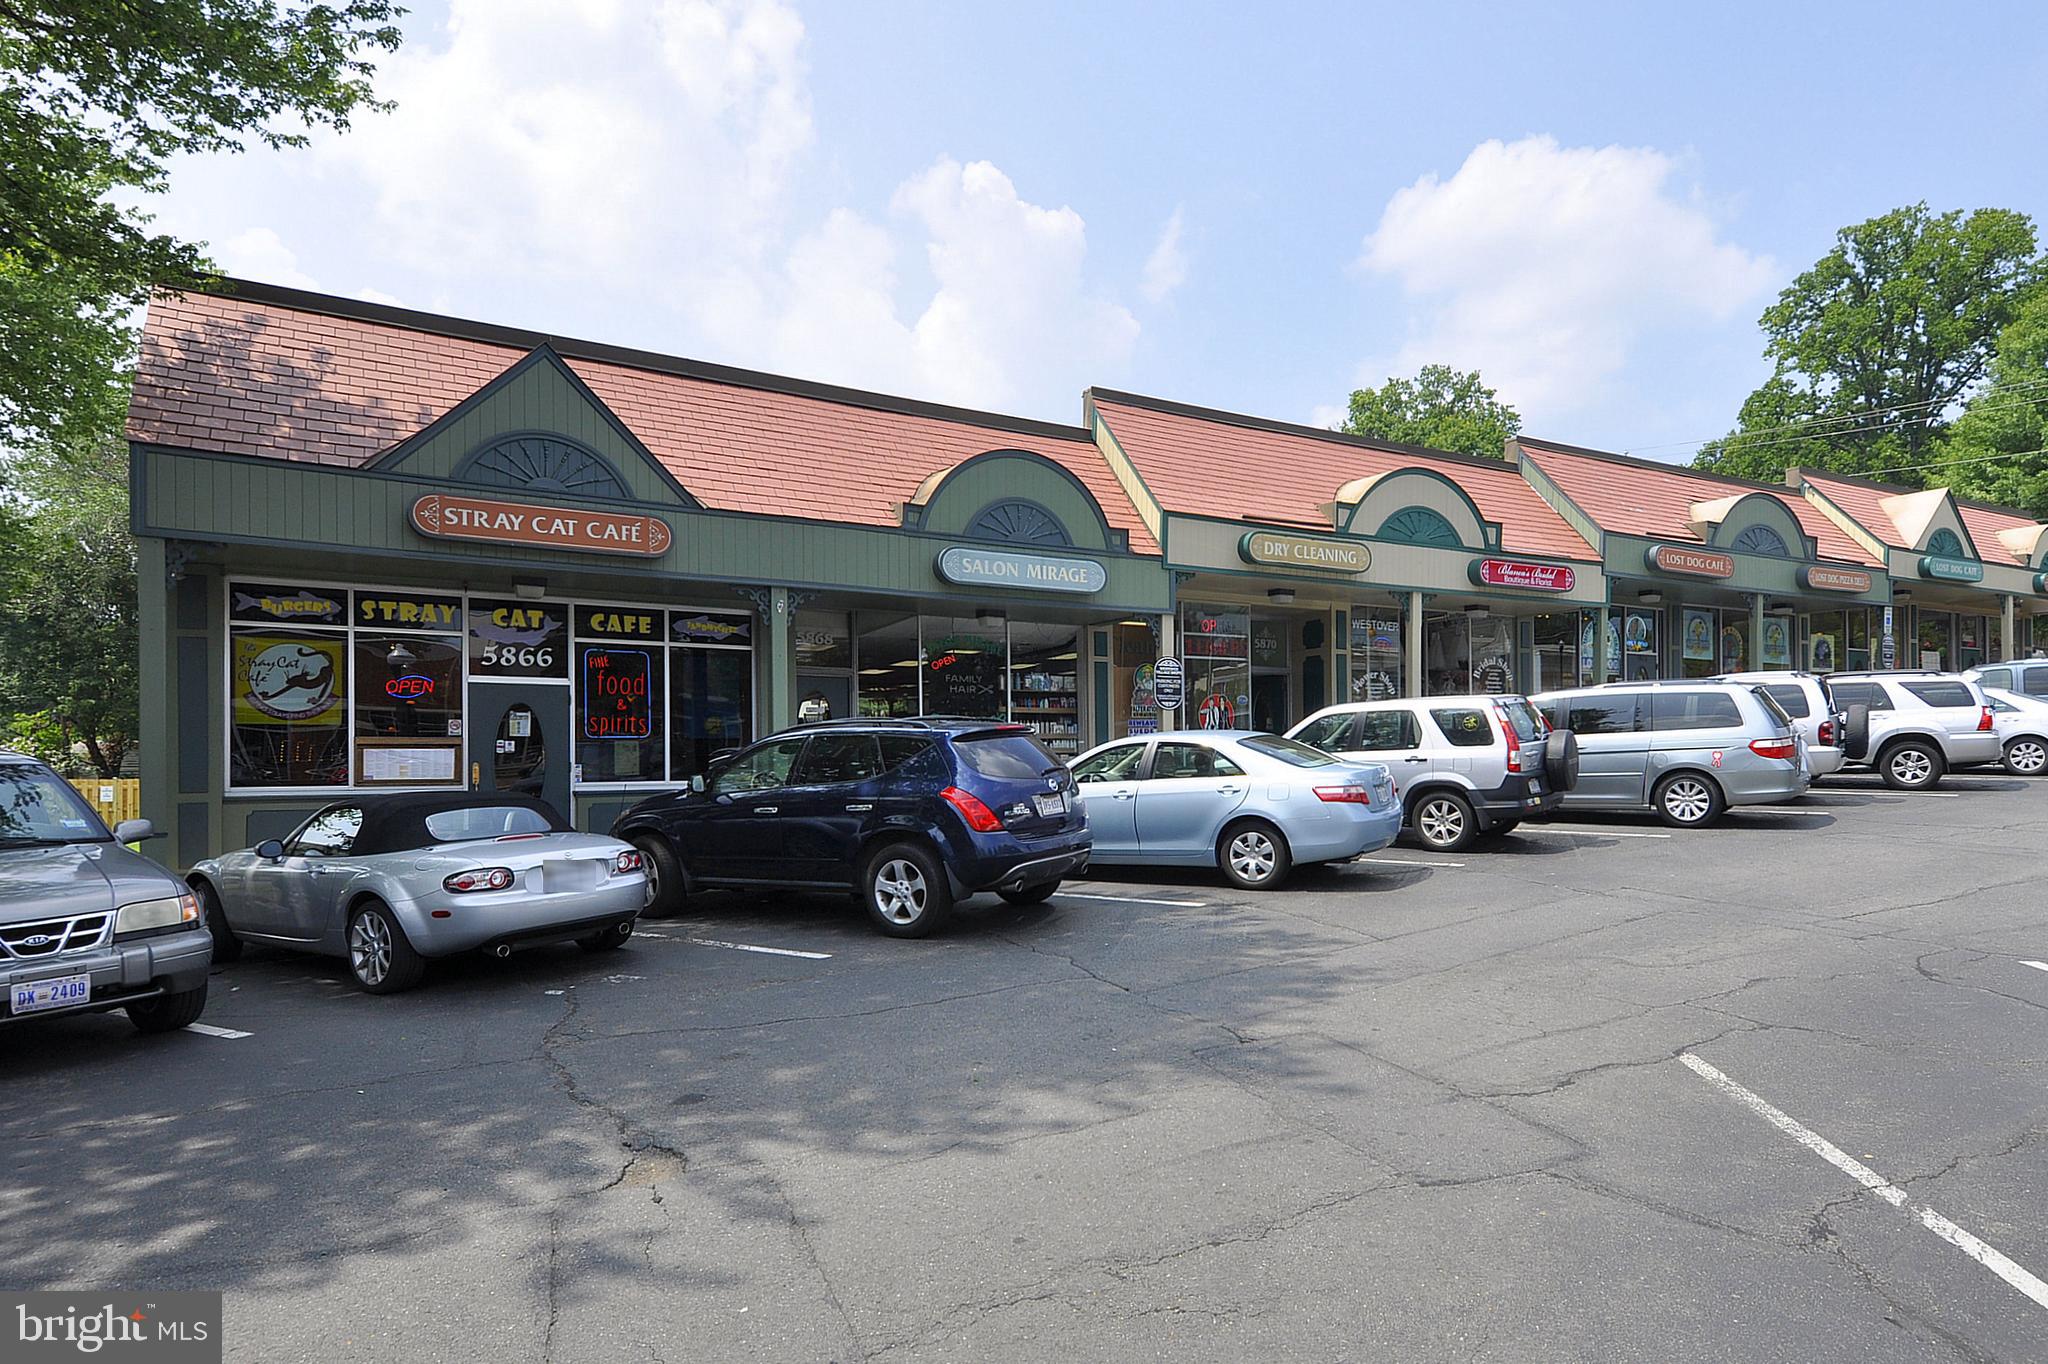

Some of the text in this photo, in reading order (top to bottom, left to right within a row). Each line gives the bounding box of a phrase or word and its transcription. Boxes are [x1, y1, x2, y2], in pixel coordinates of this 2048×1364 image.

[444, 506, 643, 543] STRAY CAT CAFÉ
[1264, 541, 1357, 564] DRY CLEANING
[1666, 554, 1685, 565] LOST
[1687, 556, 1705, 568] DOG
[1935, 562, 1950, 572] LOST
[1951, 565, 1963, 574] DOG
[962, 556, 1089, 584] SALON MIRAGE
[1531, 567, 1558, 580] Bridal
[1503, 575, 1530, 585] Boutique
[1530, 577, 1536, 585] &
[1828, 574, 1839, 583] DOG
[260, 598, 332, 615] BURGERS
[360, 600, 652, 634] STRAY CAT CAFE
[1352, 618, 1400, 632] WESTOVER
[795, 631, 834, 646] 5868
[1254, 638, 1277, 649] 5870
[239, 655, 300, 672] Stray Cat
[480, 643, 553, 668] 5866
[589, 655, 610, 670] FINE
[931, 654, 957, 671] OPEN
[1473, 656, 1496, 679] Bridal
[1497, 657, 1513, 681] Shop
[238, 670, 271, 687] Café
[385, 679, 435, 694] OPEN
[596, 670, 645, 696] food
[945, 674, 982, 683] FAMILY
[1353, 671, 1379, 694] Flower
[1379, 671, 1396, 695] Shop
[949, 684, 977, 694] HAIR
[616, 698, 627, 711] &
[589, 715, 647, 736] spirits
[27, 936, 49, 945] KIA
[50, 982, 86, 1001] 2409
